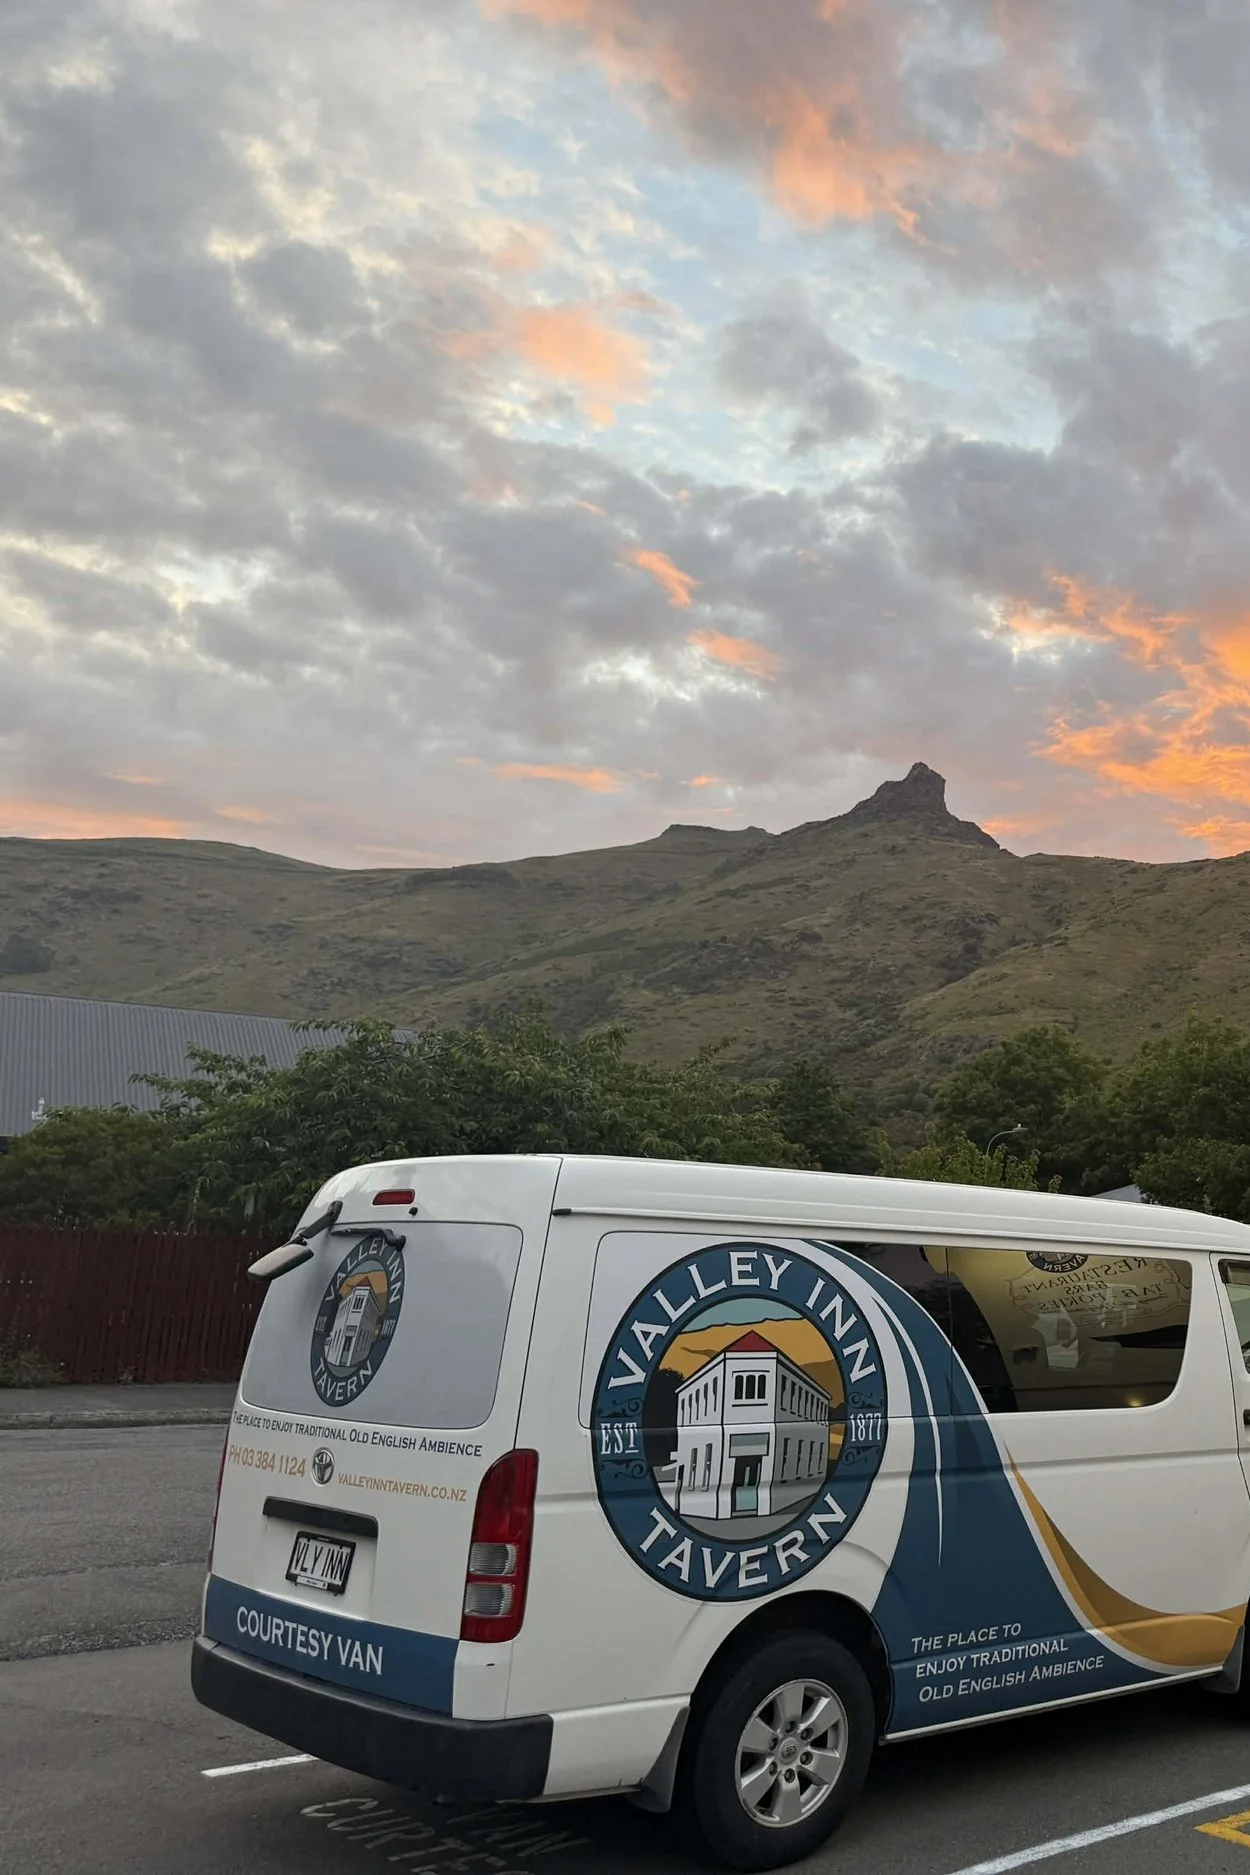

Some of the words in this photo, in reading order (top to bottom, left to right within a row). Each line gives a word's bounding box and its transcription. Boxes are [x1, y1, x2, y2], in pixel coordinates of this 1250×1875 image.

[325, 1237, 387, 1300] VALLEY
[386, 1250, 401, 1303] INN
[608, 1250, 793, 1389] VALLEY
[805, 1277, 877, 1384] INN
[314, 1357, 373, 1401] TAVERN
[232, 1410, 243, 1424] THE
[243, 1414, 262, 1429] PLACE
[262, 1418, 271, 1430] TO
[271, 1420, 294, 1433] ENJOY
[295, 1423, 347, 1441] TRADITIONAL
[349, 1428, 369, 1444] OLD
[371, 1431, 417, 1450] ENGLISH
[418, 1436, 483, 1457] AMBIENCE
[600, 1421, 639, 1454] EST
[849, 1412, 881, 1442] 1877
[229, 1444, 242, 1465] PH
[242, 1448, 254, 1467] 03
[255, 1450, 276, 1472] 384
[278, 1454, 306, 1477] 1124
[338, 1471, 468, 1502] VALLEYINNTAVERN.CO.NZ
[639, 1493, 849, 1589] TAVERN
[236, 1606, 334, 1660] COURTESY
[337, 1636, 383, 1675] VAN
[911, 1635, 943, 1653] THE
[947, 1626, 999, 1648] PLACE
[1002, 1623, 1022, 1638] TO
[915, 1657, 967, 1678] ENJOY
[970, 1638, 1068, 1669] TRADITIONAL
[918, 1685, 953, 1703] OLD
[957, 1671, 1026, 1697] ENGLISH
[1028, 1655, 1105, 1682] AMBIENCE
